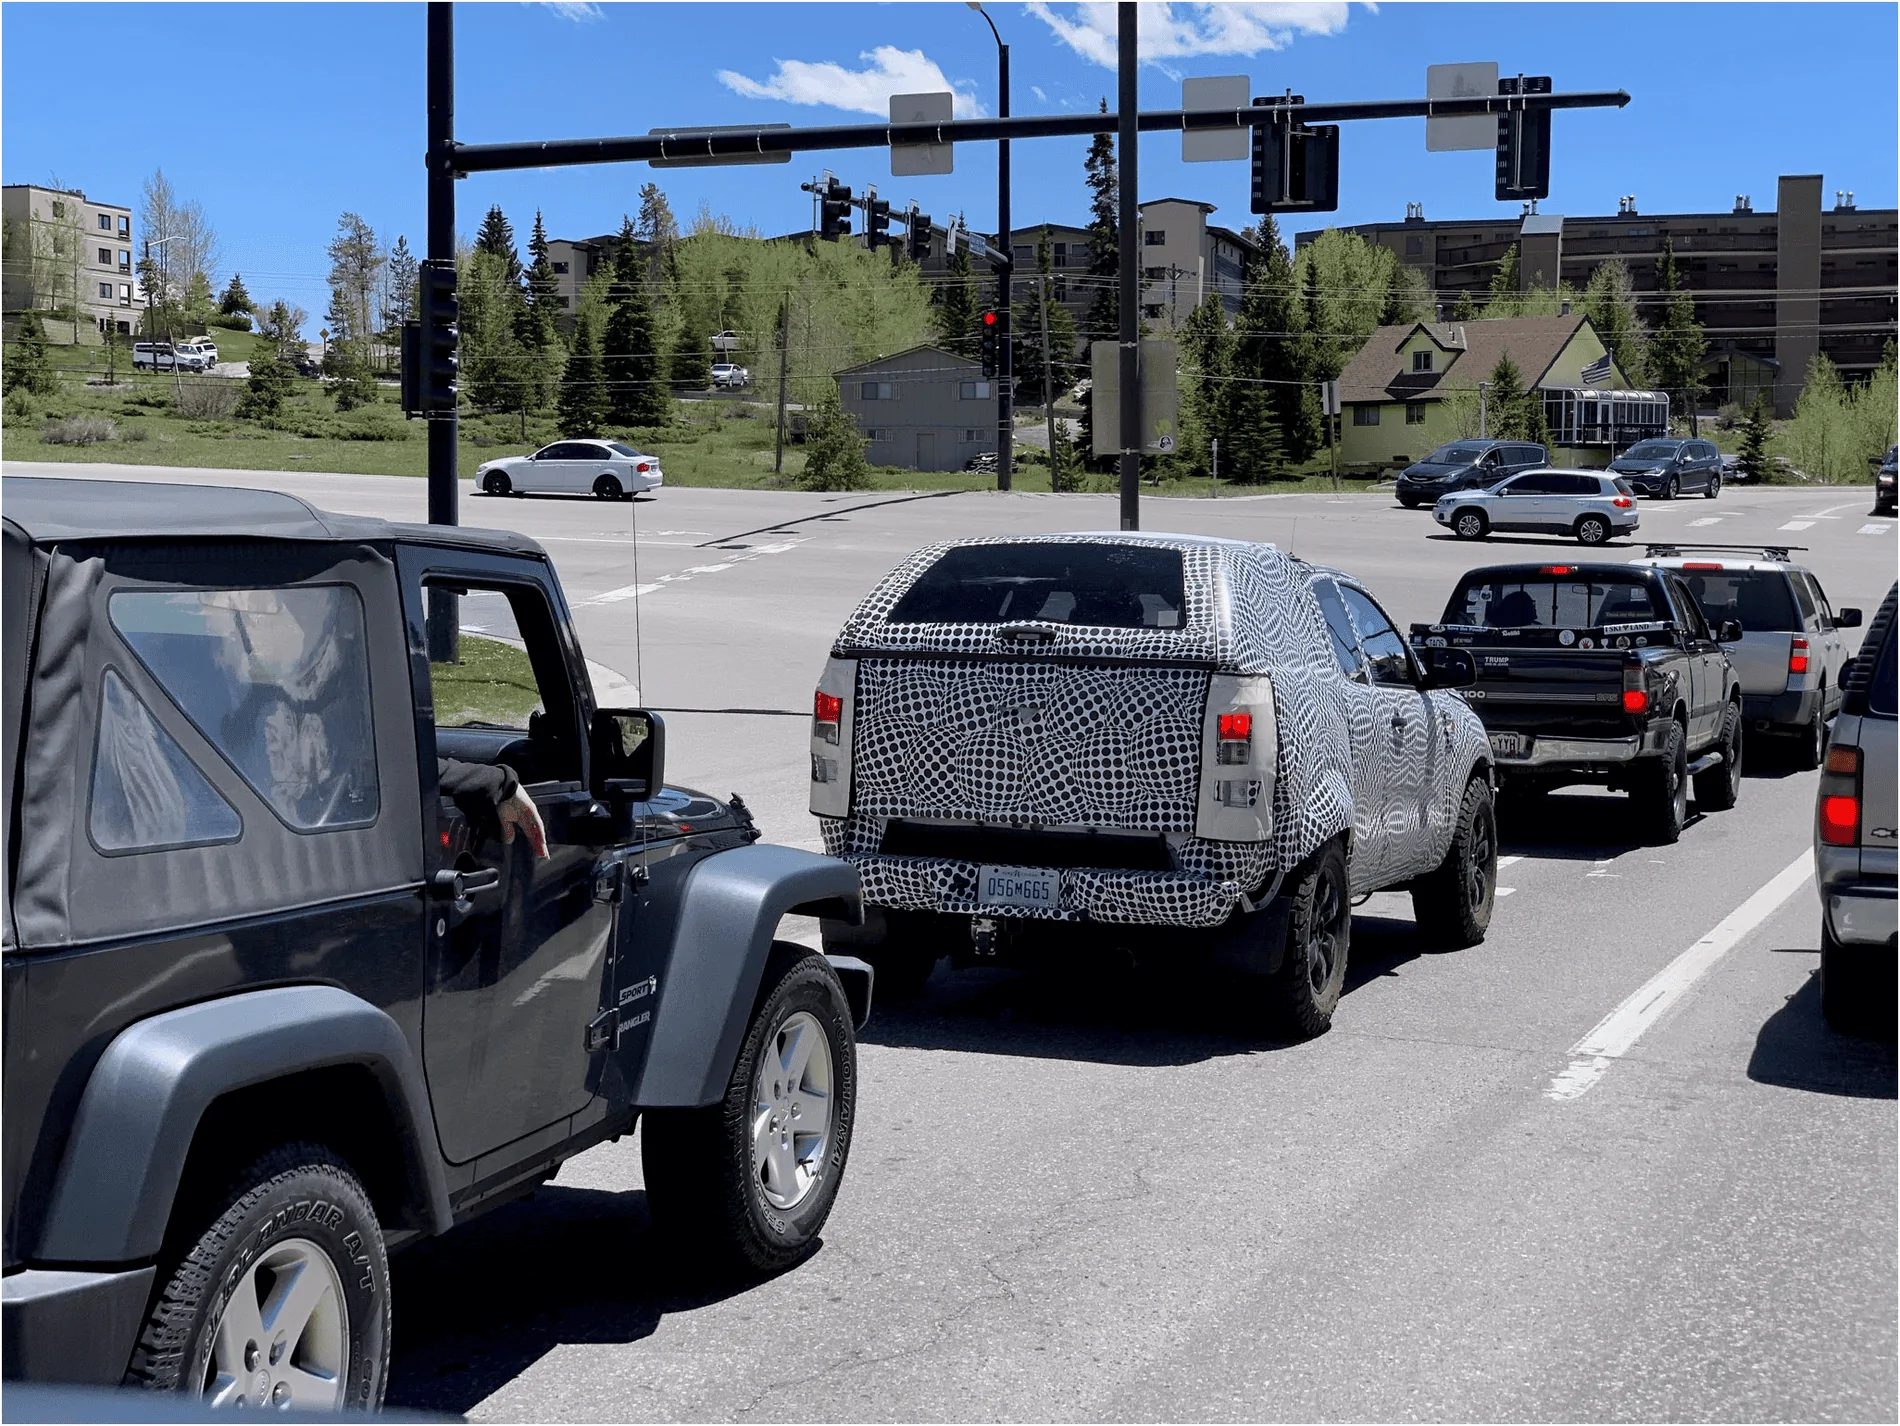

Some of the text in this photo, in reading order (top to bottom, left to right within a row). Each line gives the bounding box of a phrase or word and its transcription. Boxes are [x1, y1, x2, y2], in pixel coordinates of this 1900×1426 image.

[1630, 623, 1650, 631] LAND
[988, 877, 1050, 900] 056M665
[620, 983, 649, 1001] SPORT
[618, 1010, 651, 1033] RANGLER
[832, 1009, 851, 1169] YOKOHAMA
[342, 1231, 376, 1294] A/T
